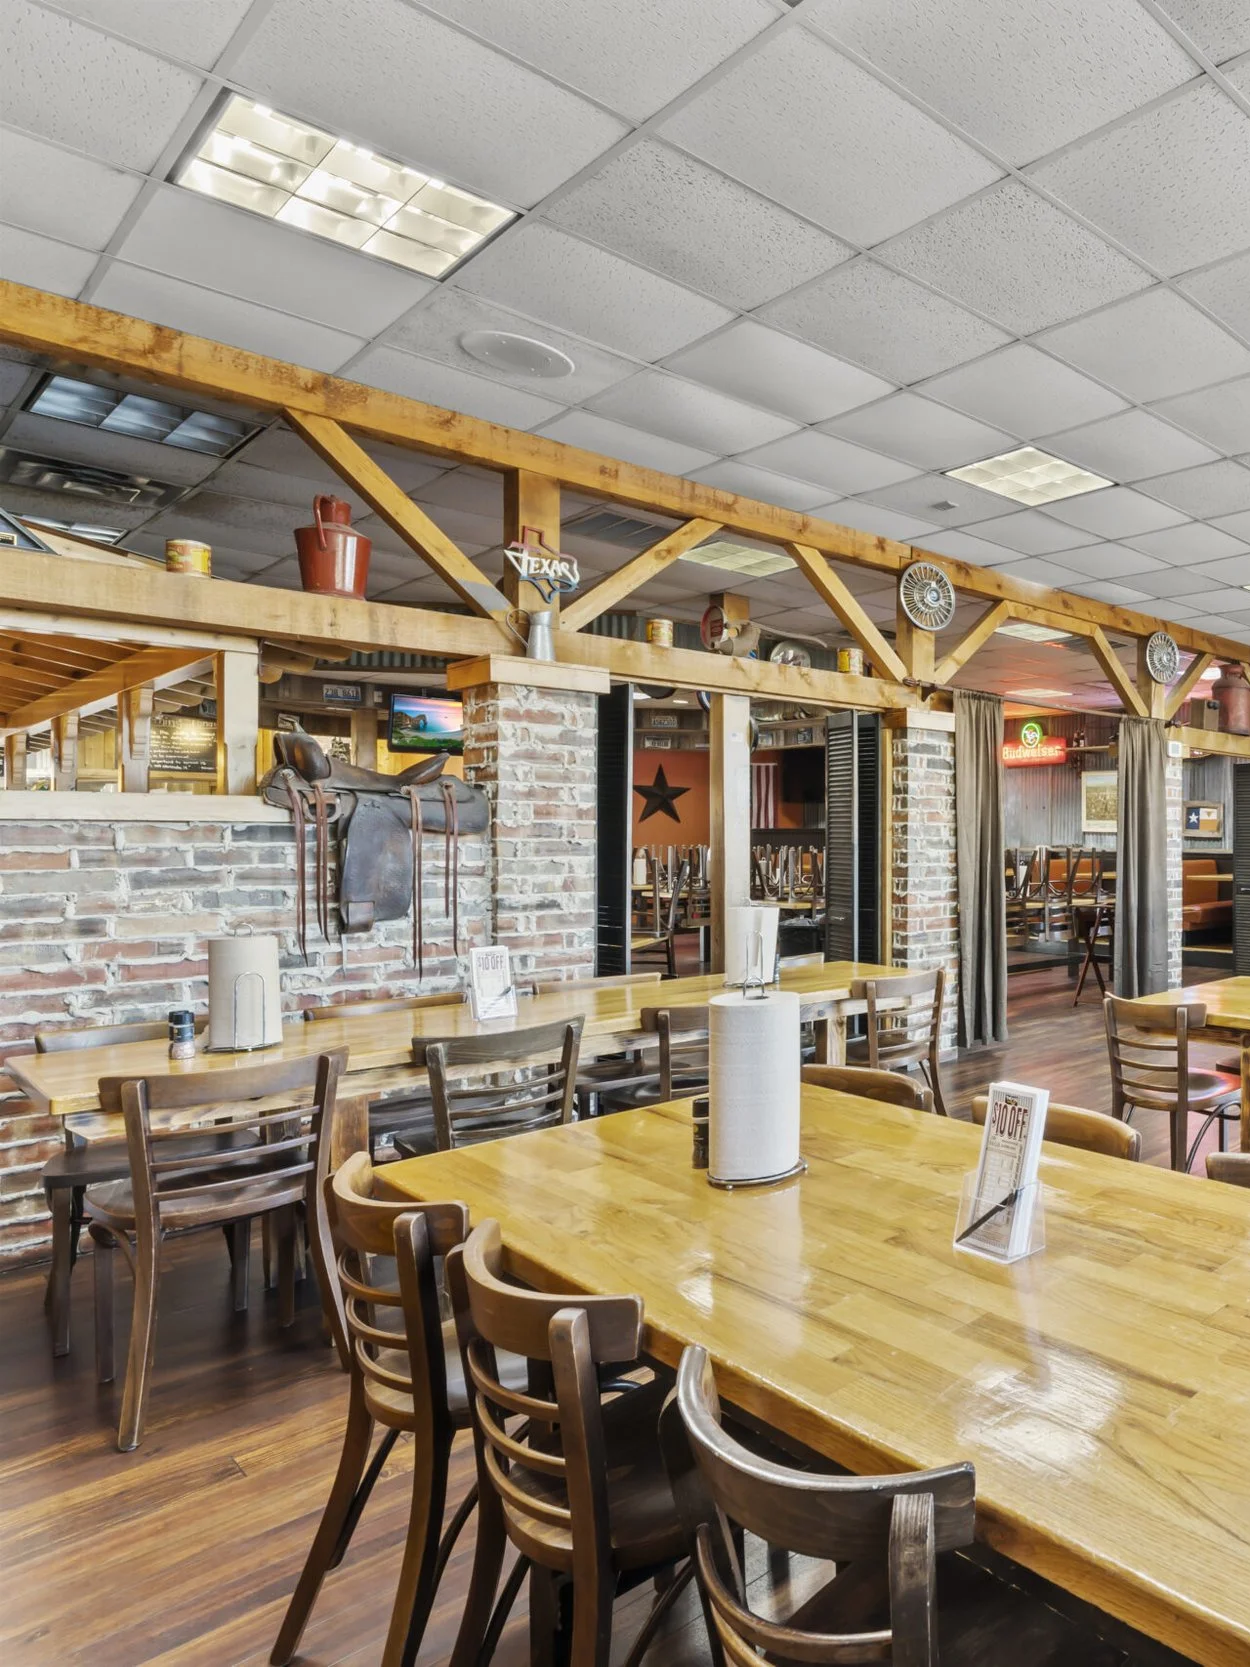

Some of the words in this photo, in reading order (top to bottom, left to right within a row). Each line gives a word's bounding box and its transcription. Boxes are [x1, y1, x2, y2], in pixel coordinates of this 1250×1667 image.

[1003, 743, 1062, 760] Budweiser
[992, 1101, 1008, 1137] $10
[1008, 1104, 1029, 1141] OFF
